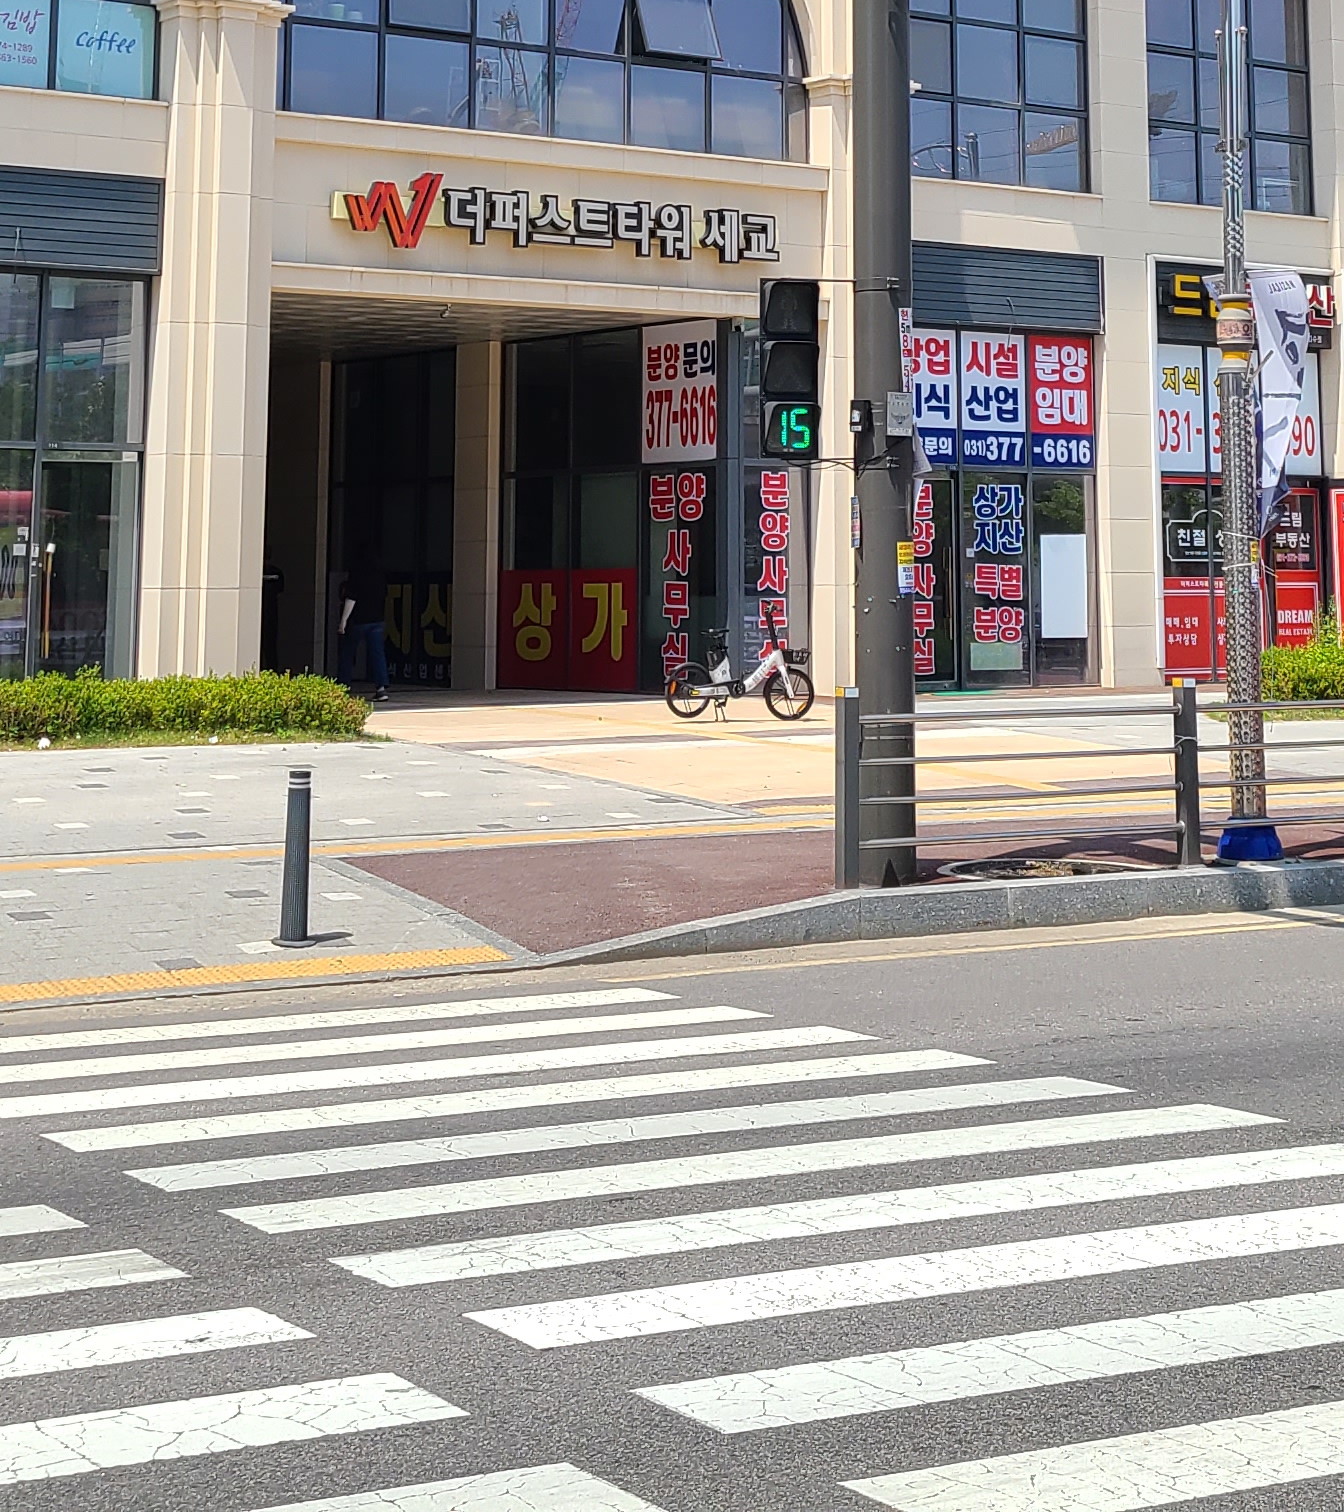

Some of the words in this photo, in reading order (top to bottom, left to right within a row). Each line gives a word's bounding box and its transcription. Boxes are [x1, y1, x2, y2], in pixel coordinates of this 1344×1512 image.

[444, 186, 692, 260] 더퍼스트타워
[701, 208, 781, 264] 세교
[647, 343, 680, 381] 분양
[683, 340, 715, 379] 문의
[966, 341, 1019, 379] 시설
[1035, 345, 1087, 384] 분양
[1162, 365, 1200, 396] 지식
[646, 384, 716, 450] 377-6616
[966, 385, 1019, 423] 산업
[1035, 387, 1087, 426] 임대
[780, 407, 810, 450] 15
[649, 472, 706, 522] 분양
[973, 484, 1024, 519] 상가
[973, 519, 1024, 554] 지산
[1177, 528, 1205, 548] 친절
[1275, 532, 1310, 548] 부동산
[974, 563, 1023, 600] 특별
[513, 582, 628, 662] 상가
[973, 606, 1024, 643] 분양
[1277, 609, 1313, 624] DREAM
